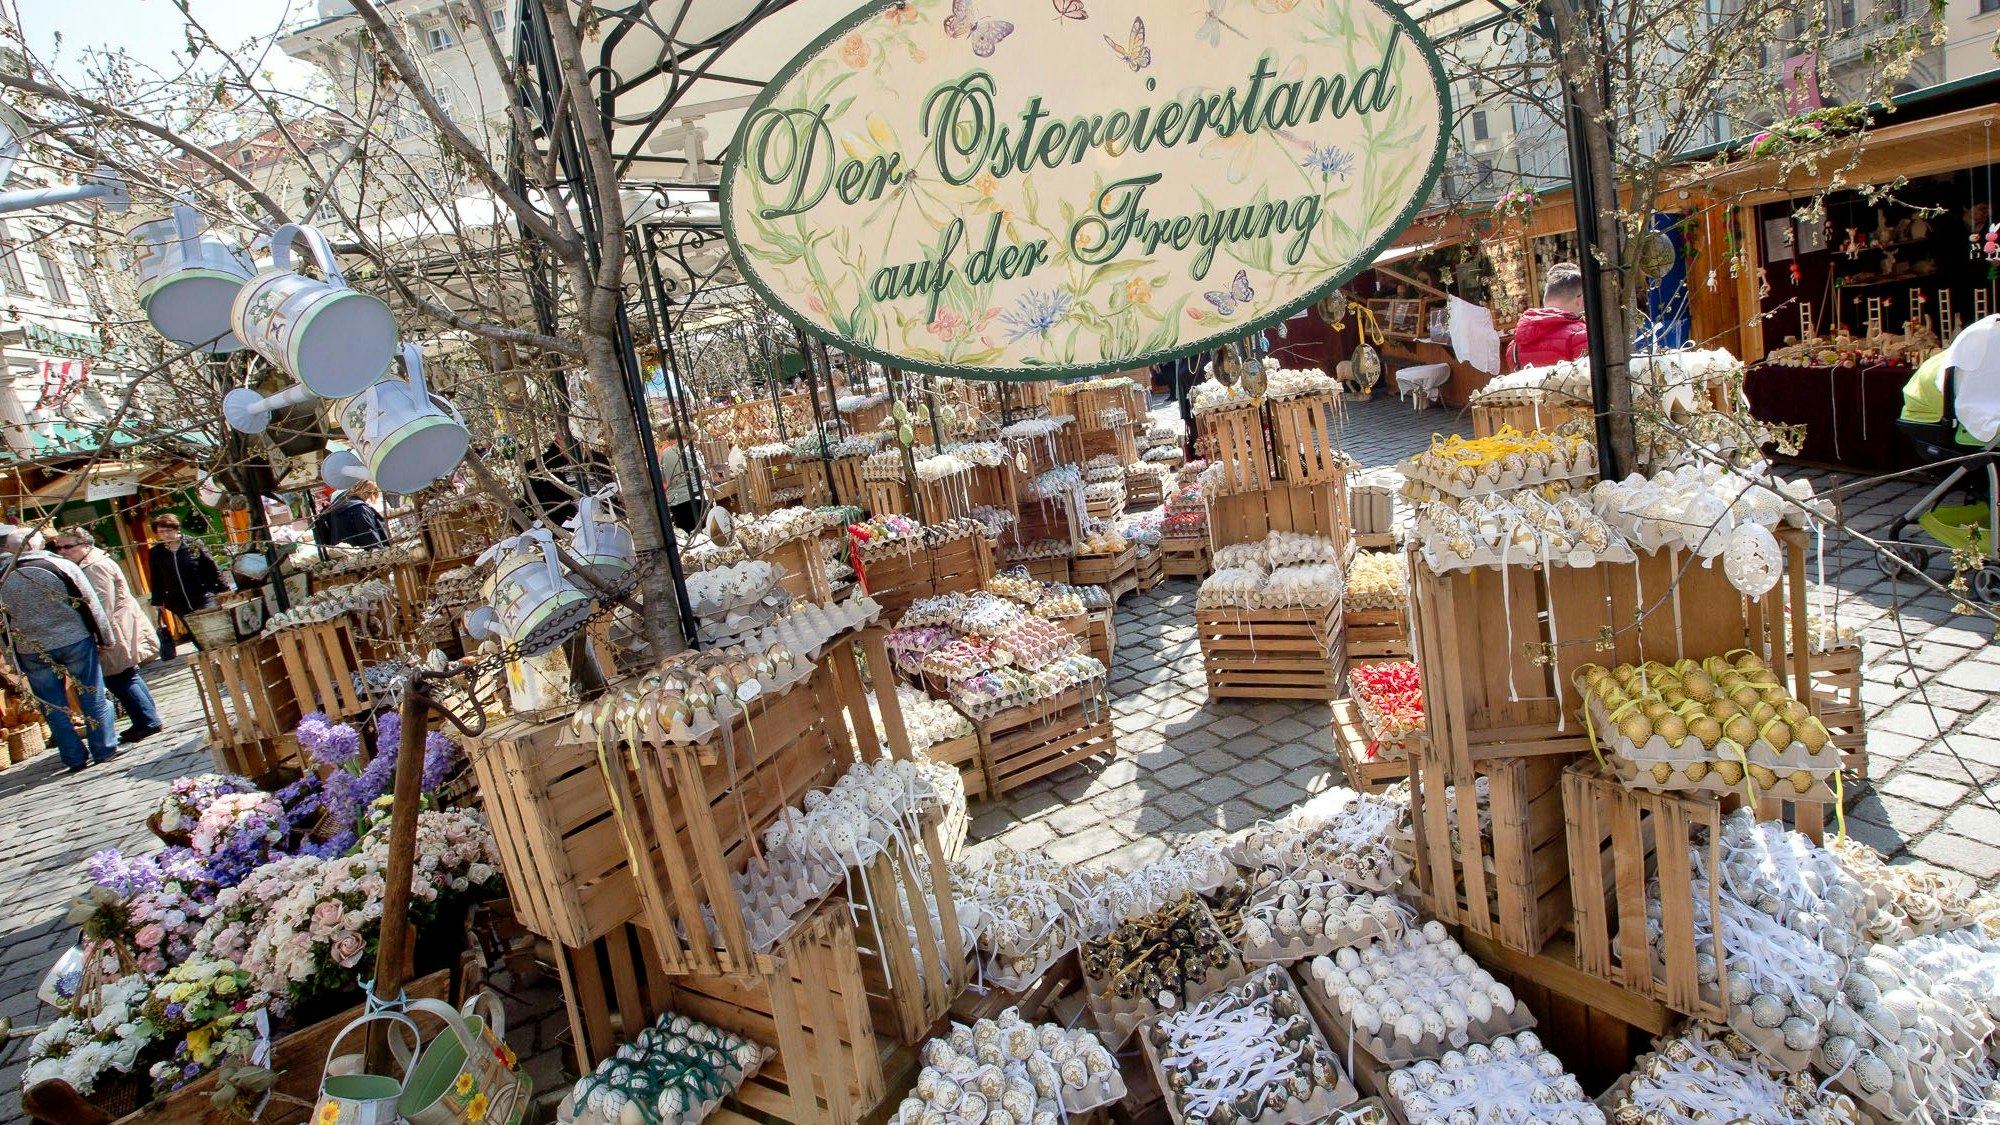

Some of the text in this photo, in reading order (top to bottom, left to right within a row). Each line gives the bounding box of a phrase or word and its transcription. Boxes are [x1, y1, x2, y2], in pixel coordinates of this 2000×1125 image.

[742, 22, 1399, 220] Der Ostereierstand
[870, 172, 1324, 325] auf der Freyung
